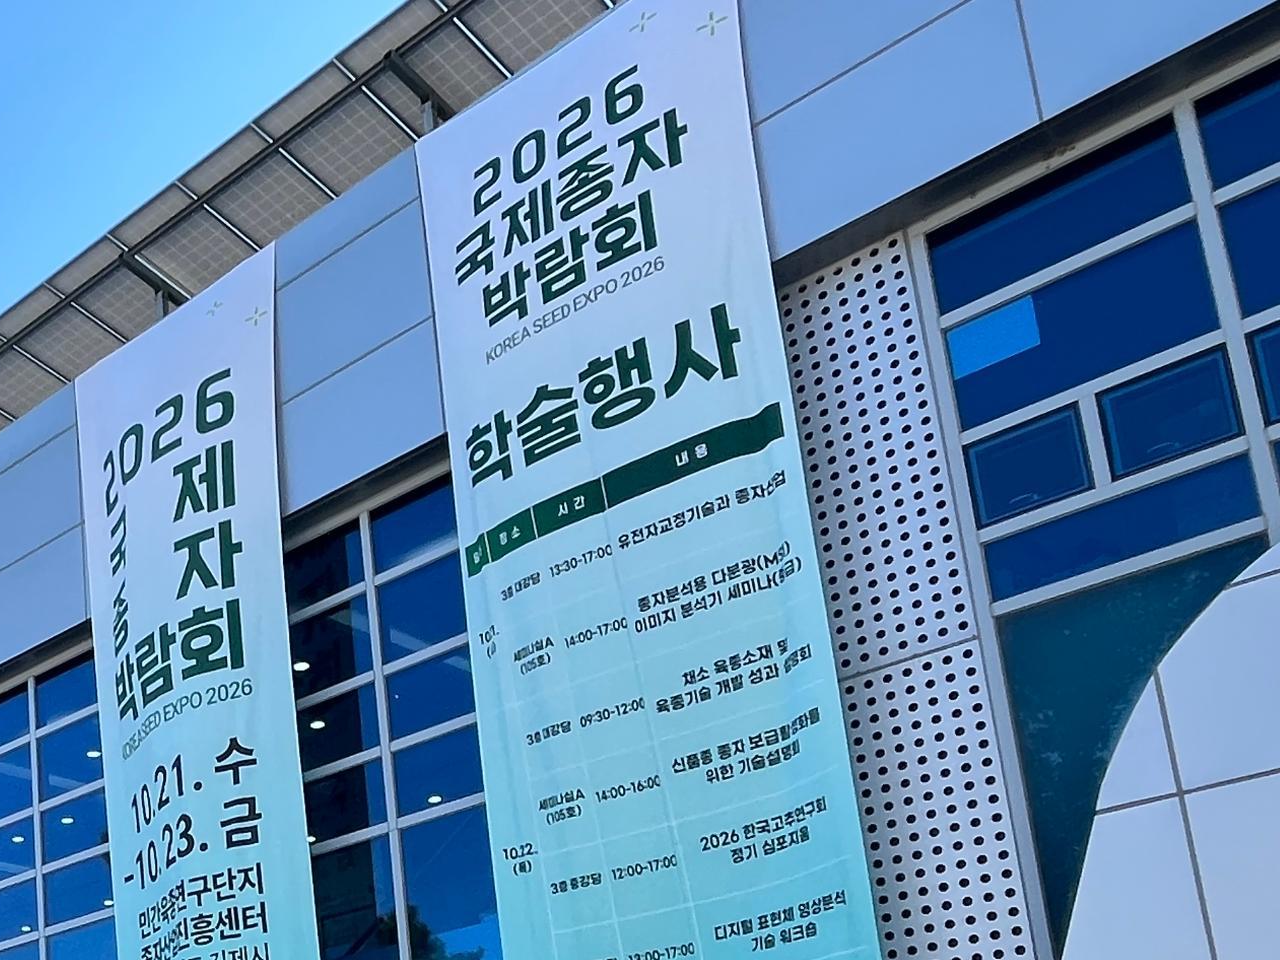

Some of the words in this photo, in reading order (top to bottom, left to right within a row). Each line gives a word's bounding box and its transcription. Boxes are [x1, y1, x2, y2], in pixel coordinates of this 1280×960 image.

[473, 64, 645, 216] 2026
[455, 107, 688, 286] 국제종자
[482, 189, 658, 328] 박람회
[485, 326, 531, 365] KOREA
[532, 303, 571, 335] SEED
[573, 278, 618, 311] EXPO
[621, 256, 665, 287] 2026
[466, 303, 741, 487] 학술행사
[103, 368, 235, 517] 2026
[618, 495, 730, 549] 유전자교정기술과
[549, 544, 613, 577] 13:30-17:00
[635, 608, 676, 633] 이미지
[681, 591, 722, 618] 분석기
[638, 576, 707, 612] 종자분석용
[564, 617, 628, 648] 14:00-17:00
[116, 599, 244, 720] 박람회
[682, 667, 710, 687] 채소
[714, 644, 773, 674] 육종소재
[163, 692, 202, 721] EXPO
[206, 678, 252, 705] 2026
[656, 686, 711, 713] 육종기술
[715, 674, 744, 695] 개발
[748, 663, 780, 685] 성과
[579, 697, 645, 728] 09:30-12:00
[672, 749, 713, 774] 신품종
[717, 739, 745, 760] 종자
[706, 763, 734, 784] 위한
[131, 754, 202, 833] 10.21.
[215, 737, 257, 785] 수
[595, 774, 661, 803] 14:00-16:00
[220, 796, 262, 849] 금
[699, 829, 740, 851] 2026
[742, 796, 827, 840] 한국고추연구회
[611, 854, 678, 881] 12:00-17:00
[730, 843, 758, 864] 정기
[714, 919, 753, 940] 디지털
[757, 906, 794, 931] 표현체
[798, 890, 847, 918] 영상분석
[751, 933, 776, 952] 기술
[780, 921, 817, 944] 워크숍
